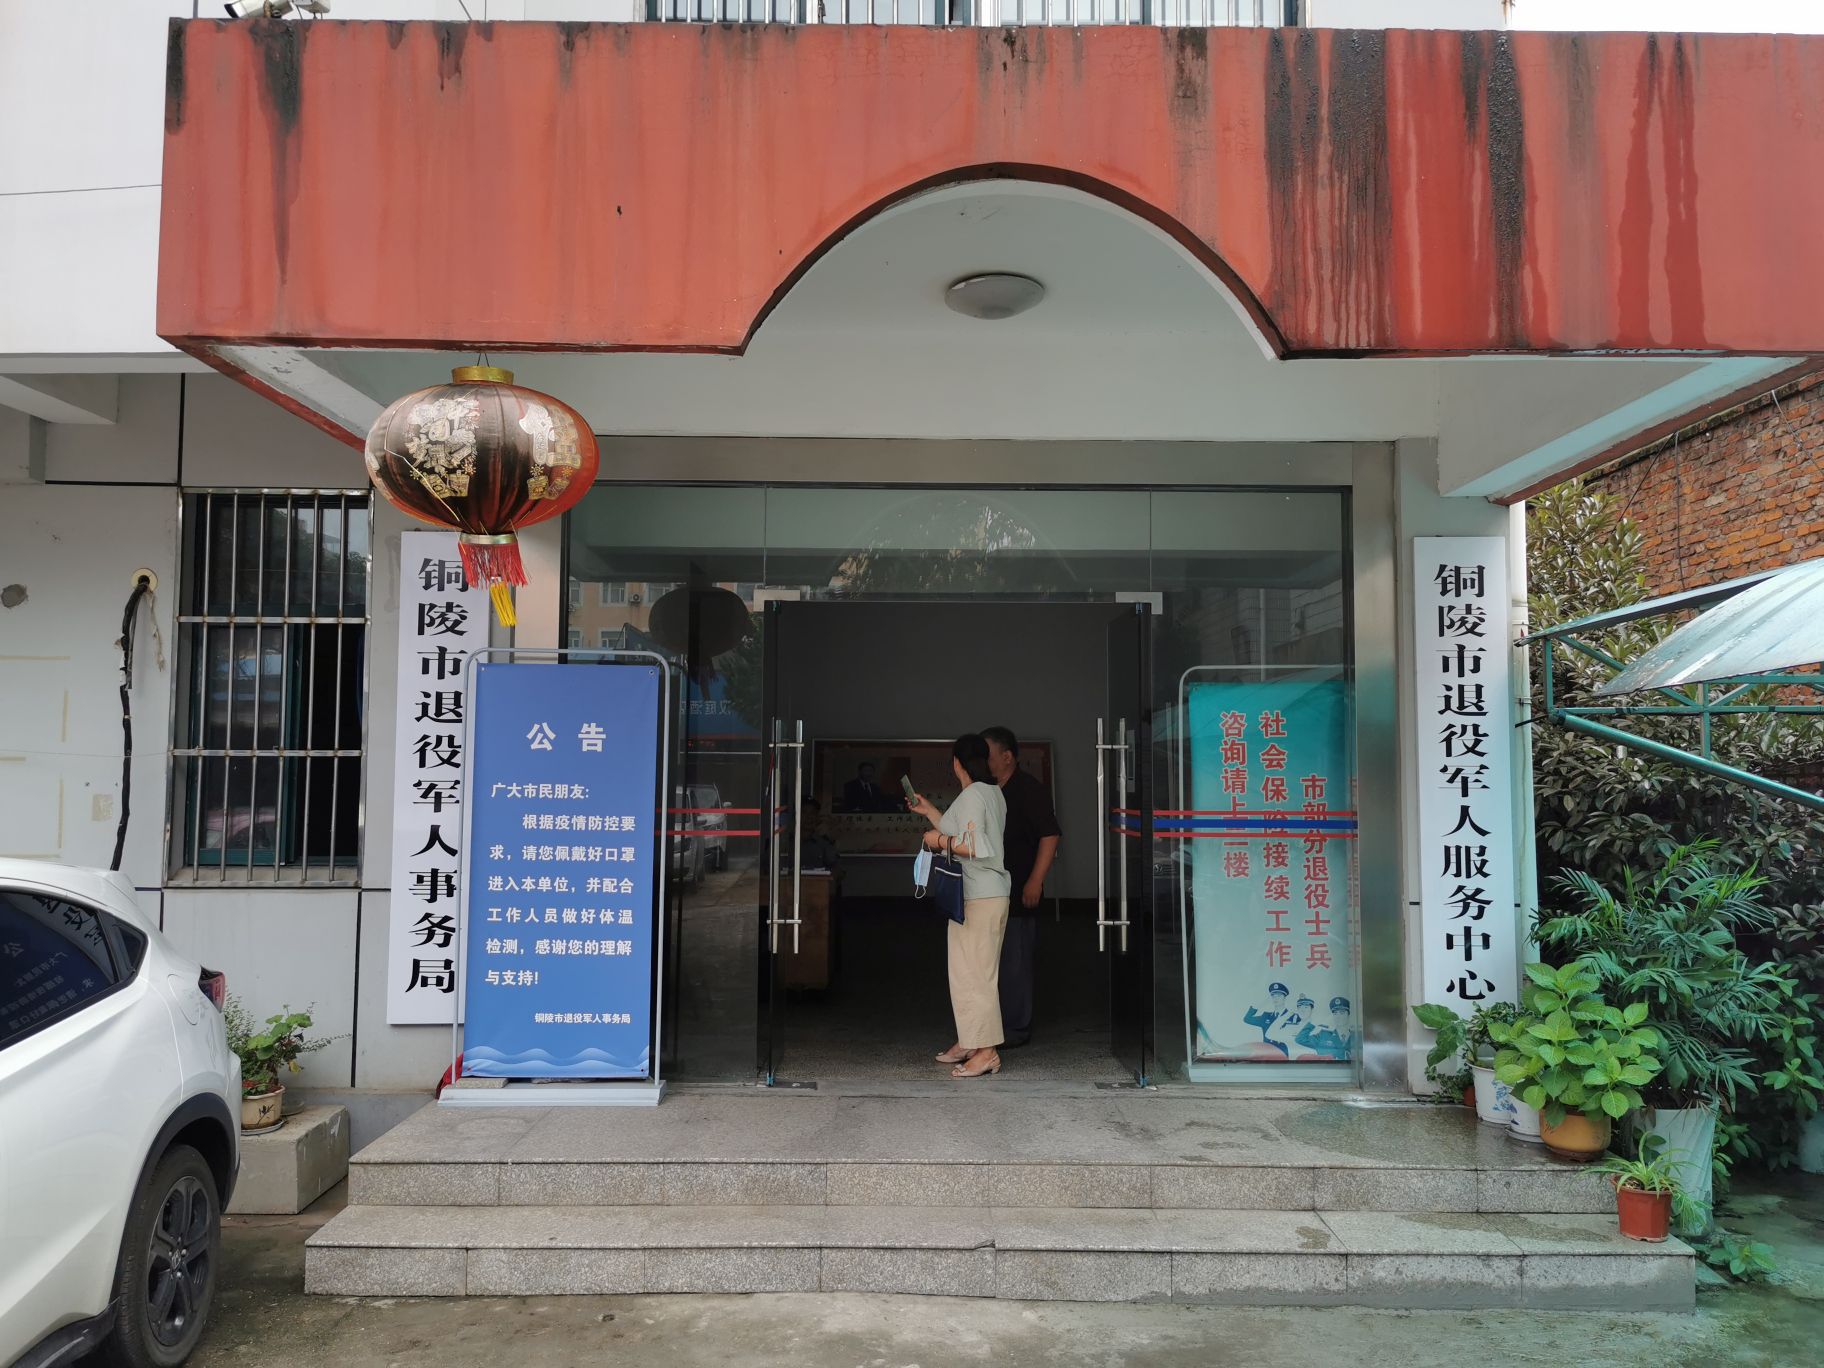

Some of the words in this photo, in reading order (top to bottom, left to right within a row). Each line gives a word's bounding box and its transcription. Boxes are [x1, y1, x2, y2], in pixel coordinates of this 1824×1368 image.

[526, 721, 607, 752] 公告
[405, 557, 469, 995] 铜陵市退役军人事务局
[1432, 563, 1496, 1001] 铜陵市退役军人服务中心
[490, 782, 590, 800] 广大市民朋友：
[522, 814, 636, 832] 根据疫情防控要
[489, 844, 636, 863] 求，请您佩戴好口罩
[1301, 773, 1333, 970] 市部分退役士兵
[487, 875, 634, 894] 进入本单位，并配合
[487, 907, 634, 925] 工作人员做好体温
[485, 938, 633, 956] 检测，感谢您的理解
[485, 969, 539, 986] 与支持！
[534, 1012, 632, 1024] 铜陵市退役军人事务局
